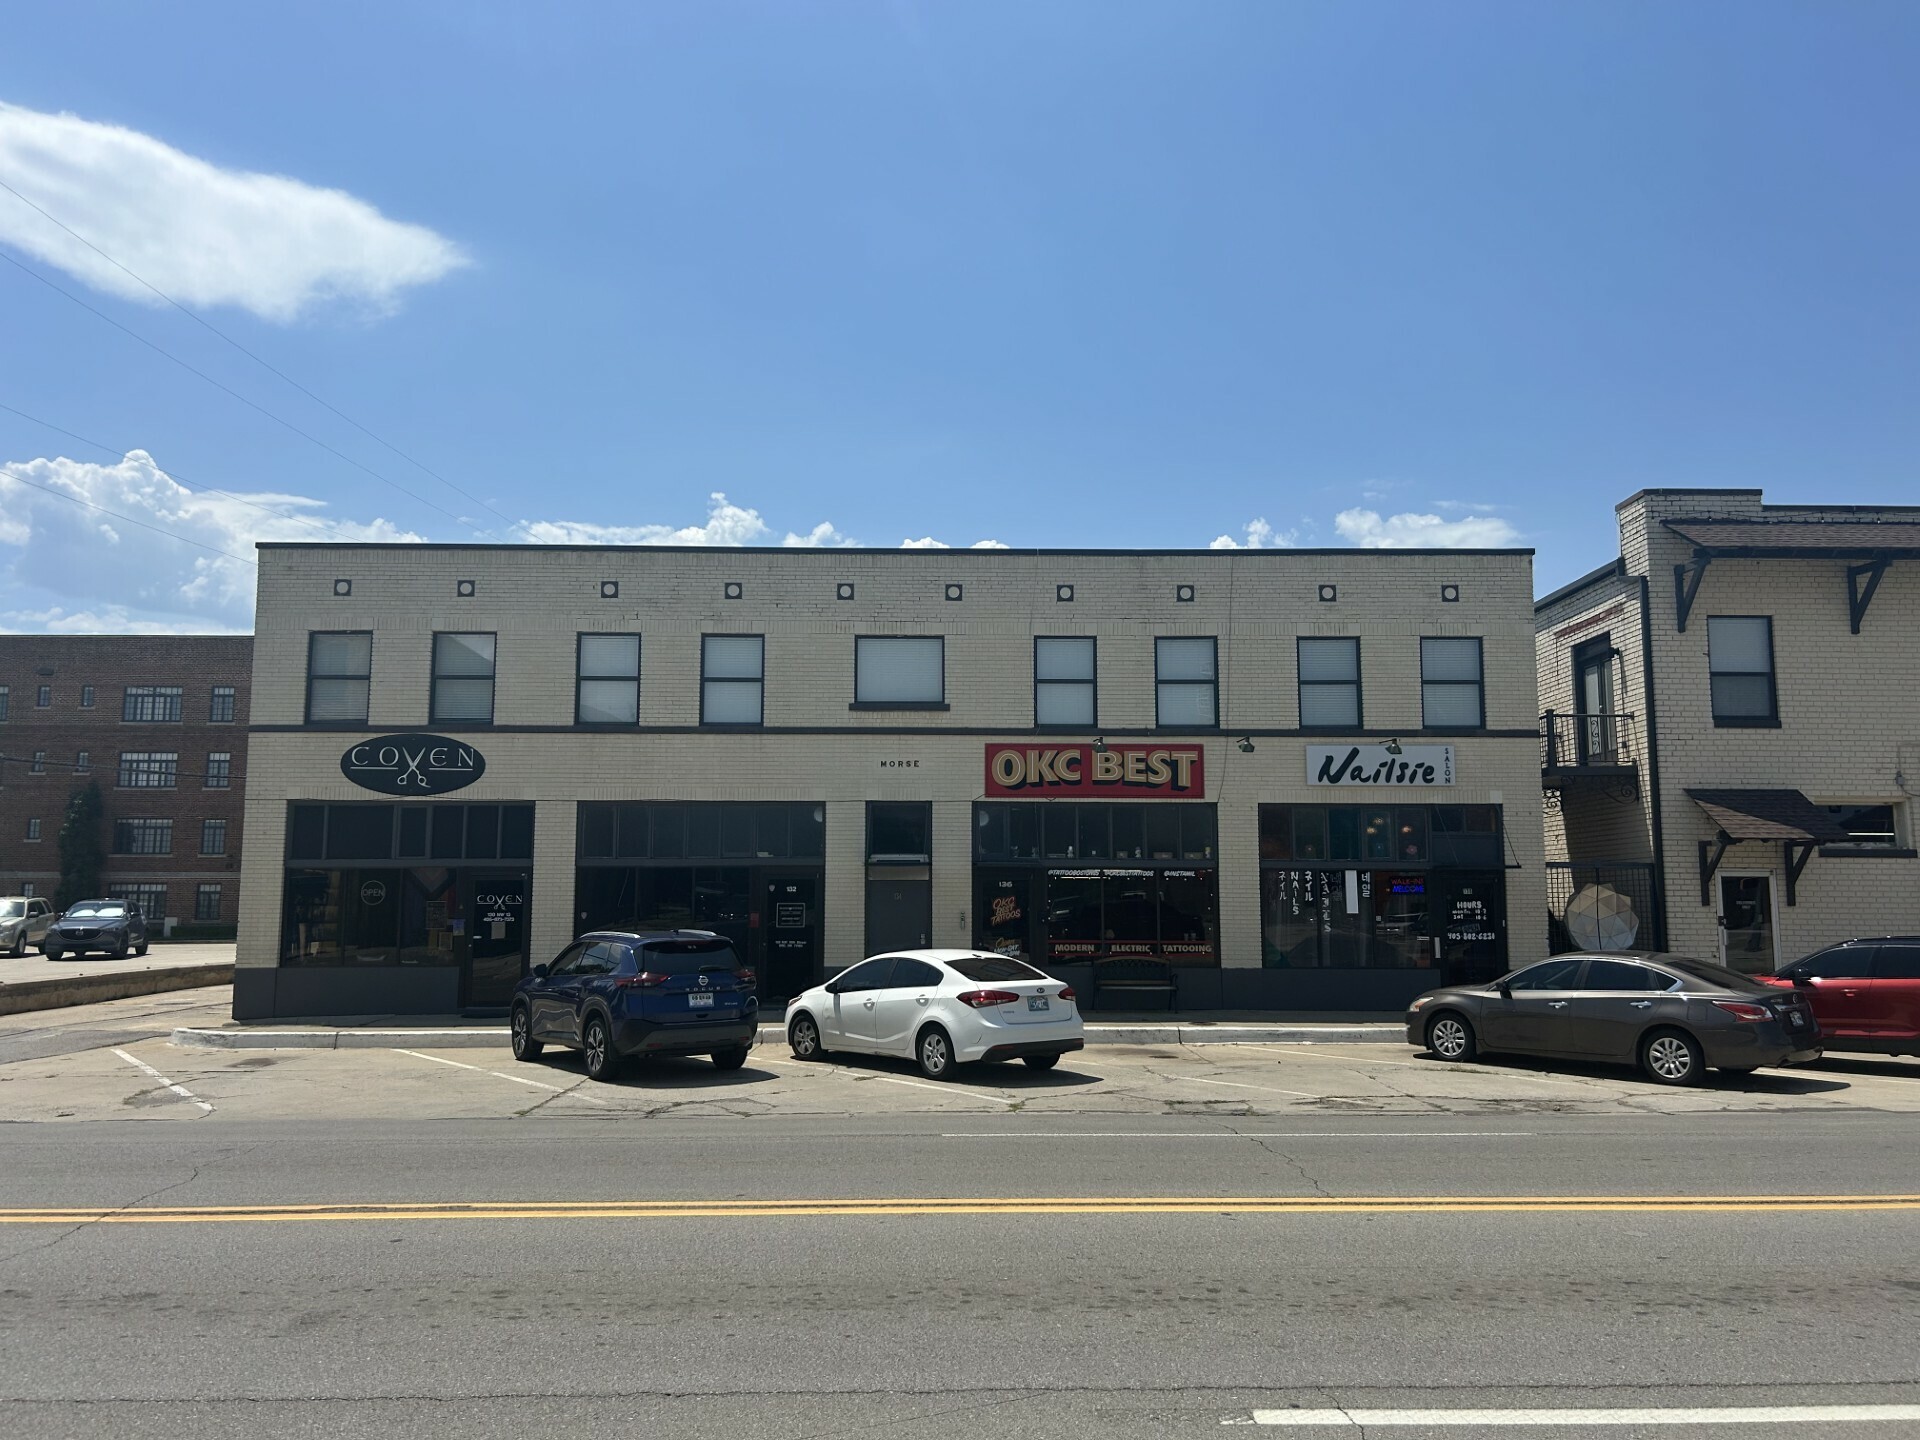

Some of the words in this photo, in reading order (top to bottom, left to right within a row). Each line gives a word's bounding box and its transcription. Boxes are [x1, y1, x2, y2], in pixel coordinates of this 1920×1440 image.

[351, 745, 474, 775] COVEN
[880, 760, 920, 768] MORSE
[1317, 746, 1435, 784] Nailsie
[991, 748, 1082, 788] OKC
[1091, 749, 1199, 790] BEST
[1304, 870, 1314, 902] ネイル
[1361, 871, 1371, 898] 네일
[1391, 885, 1425, 894] WELCOME
[361, 888, 385, 897] OPEN
[476, 894, 523, 906] COVEN
[992, 896, 1015, 910] OKC
[1456, 900, 1483, 909] HOURS
[990, 908, 1021, 926] TATTOOS
[1054, 944, 1095, 952] MODERN
[1110, 944, 1151, 952] ELECTRIC
[1163, 944, 1213, 952] TATTOOING
